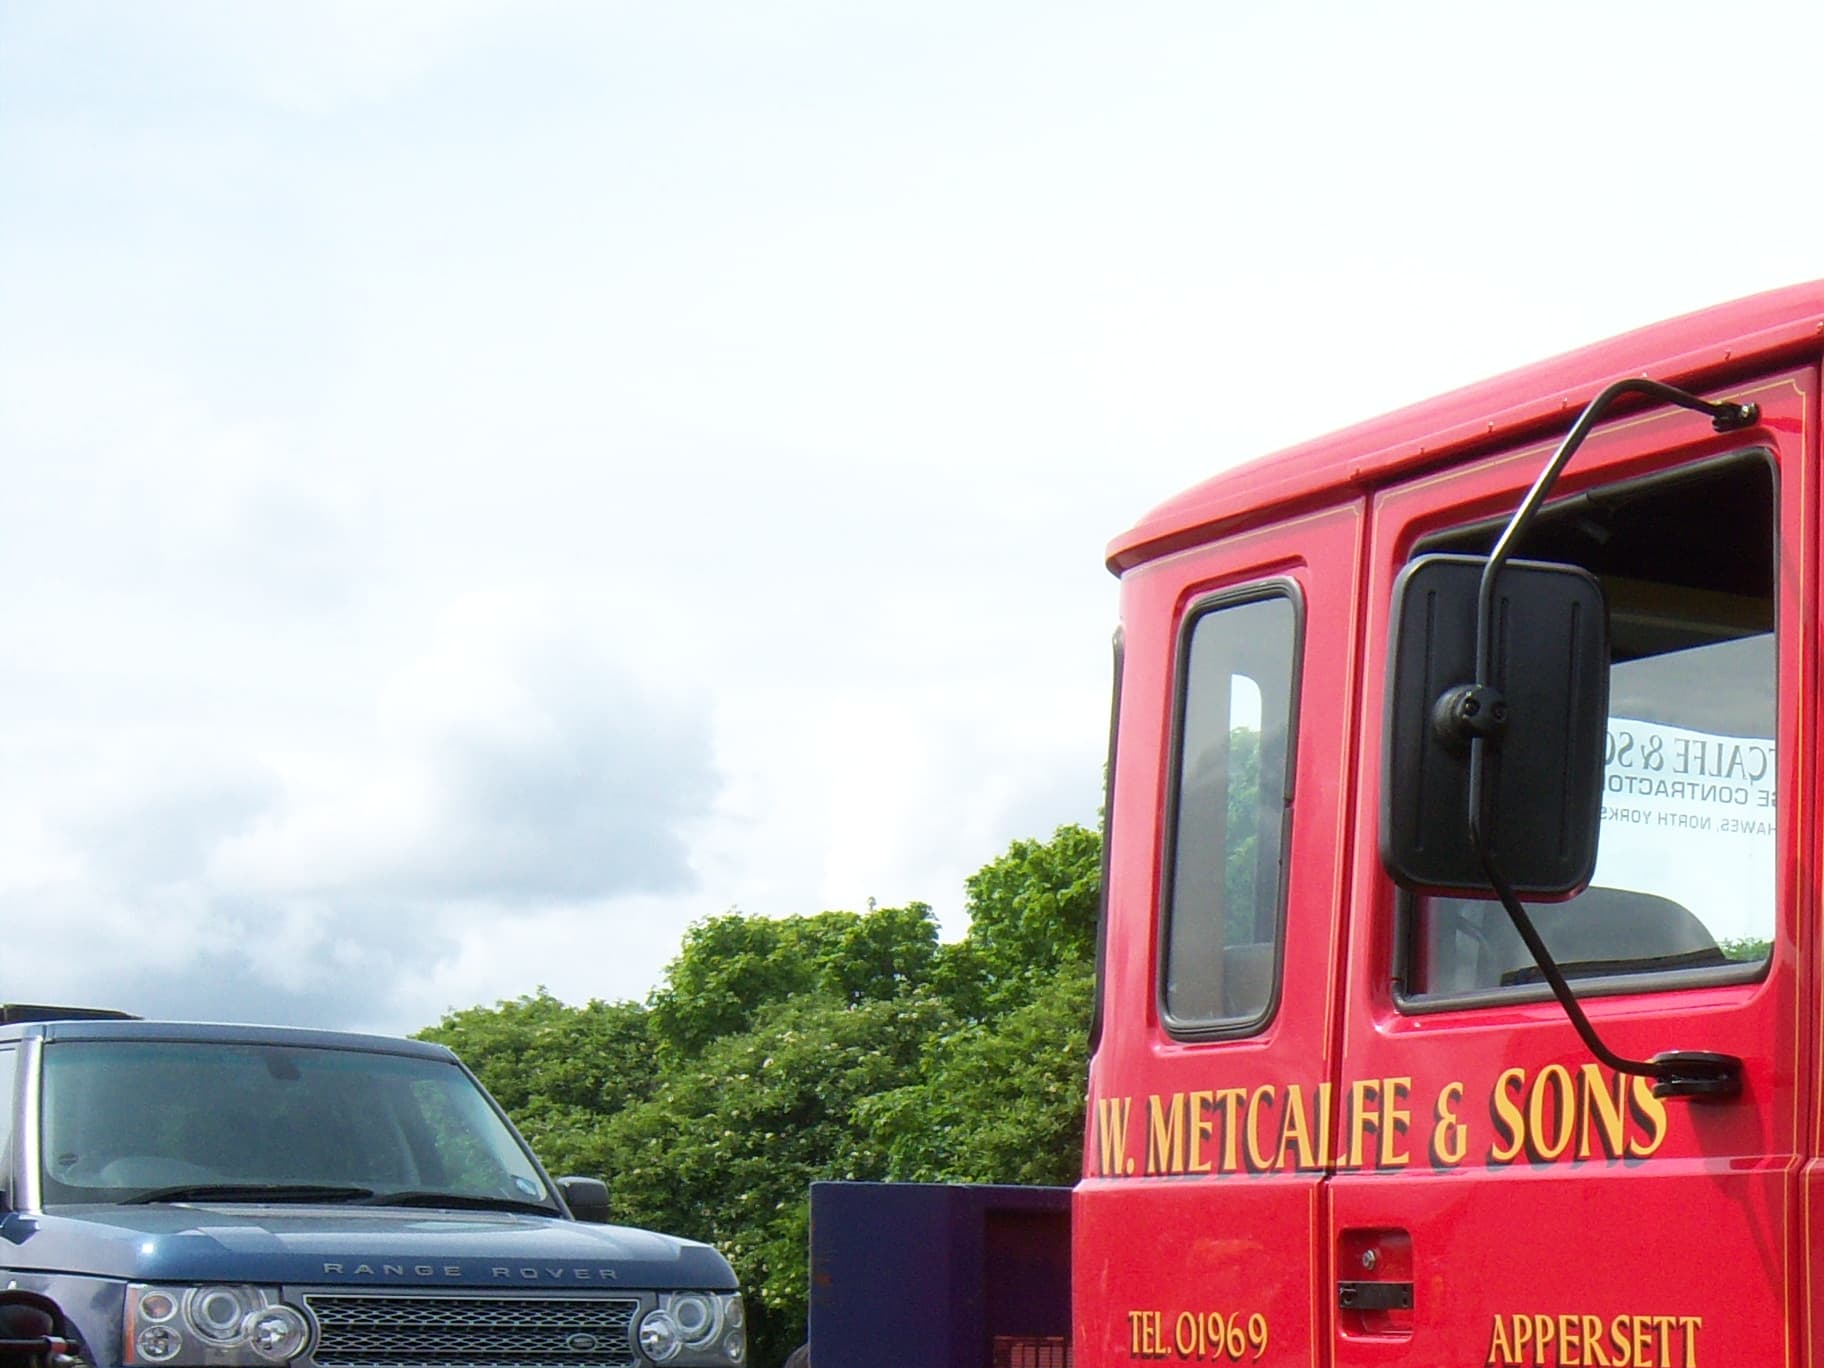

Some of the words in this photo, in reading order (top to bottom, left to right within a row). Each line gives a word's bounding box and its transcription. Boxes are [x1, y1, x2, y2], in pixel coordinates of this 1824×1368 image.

[1098, 1096, 1135, 1175] W.
[1147, 1076, 1412, 1174] METCALFE
[1433, 1081, 1468, 1164] &
[1491, 1061, 1668, 1161] SONS
[322, 1262, 463, 1278] RANGE
[491, 1266, 619, 1280] ROVER
[1127, 1310, 1172, 1355] TEL.
[1175, 1310, 1269, 1360] 01969
